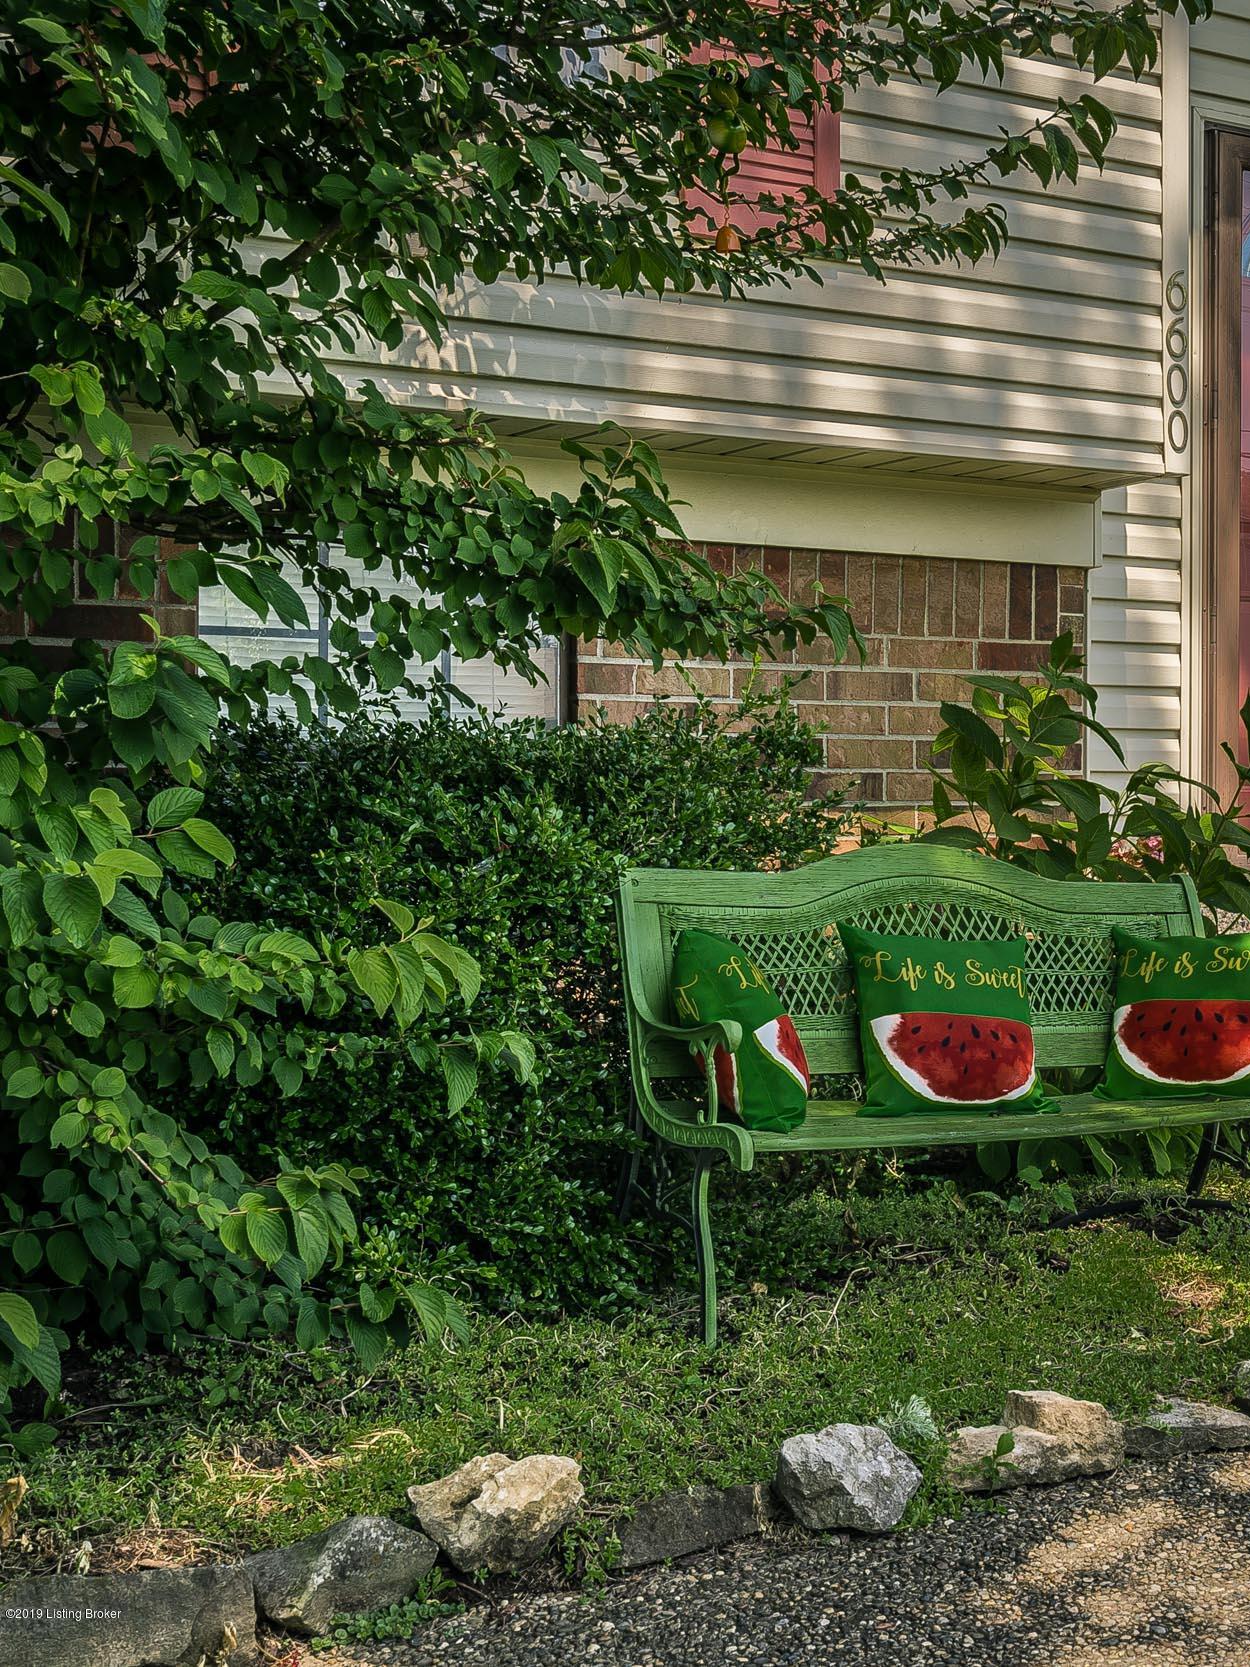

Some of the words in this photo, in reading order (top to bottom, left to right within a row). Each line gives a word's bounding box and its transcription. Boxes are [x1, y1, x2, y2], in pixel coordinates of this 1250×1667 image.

[1166, 270, 1188, 454] 6600
[859, 951, 927, 991] Life
[934, 961, 956, 990] is
[965, 959, 1026, 998] Sweet
[1120, 948, 1168, 983] Life
[1174, 952, 1199, 978] is
